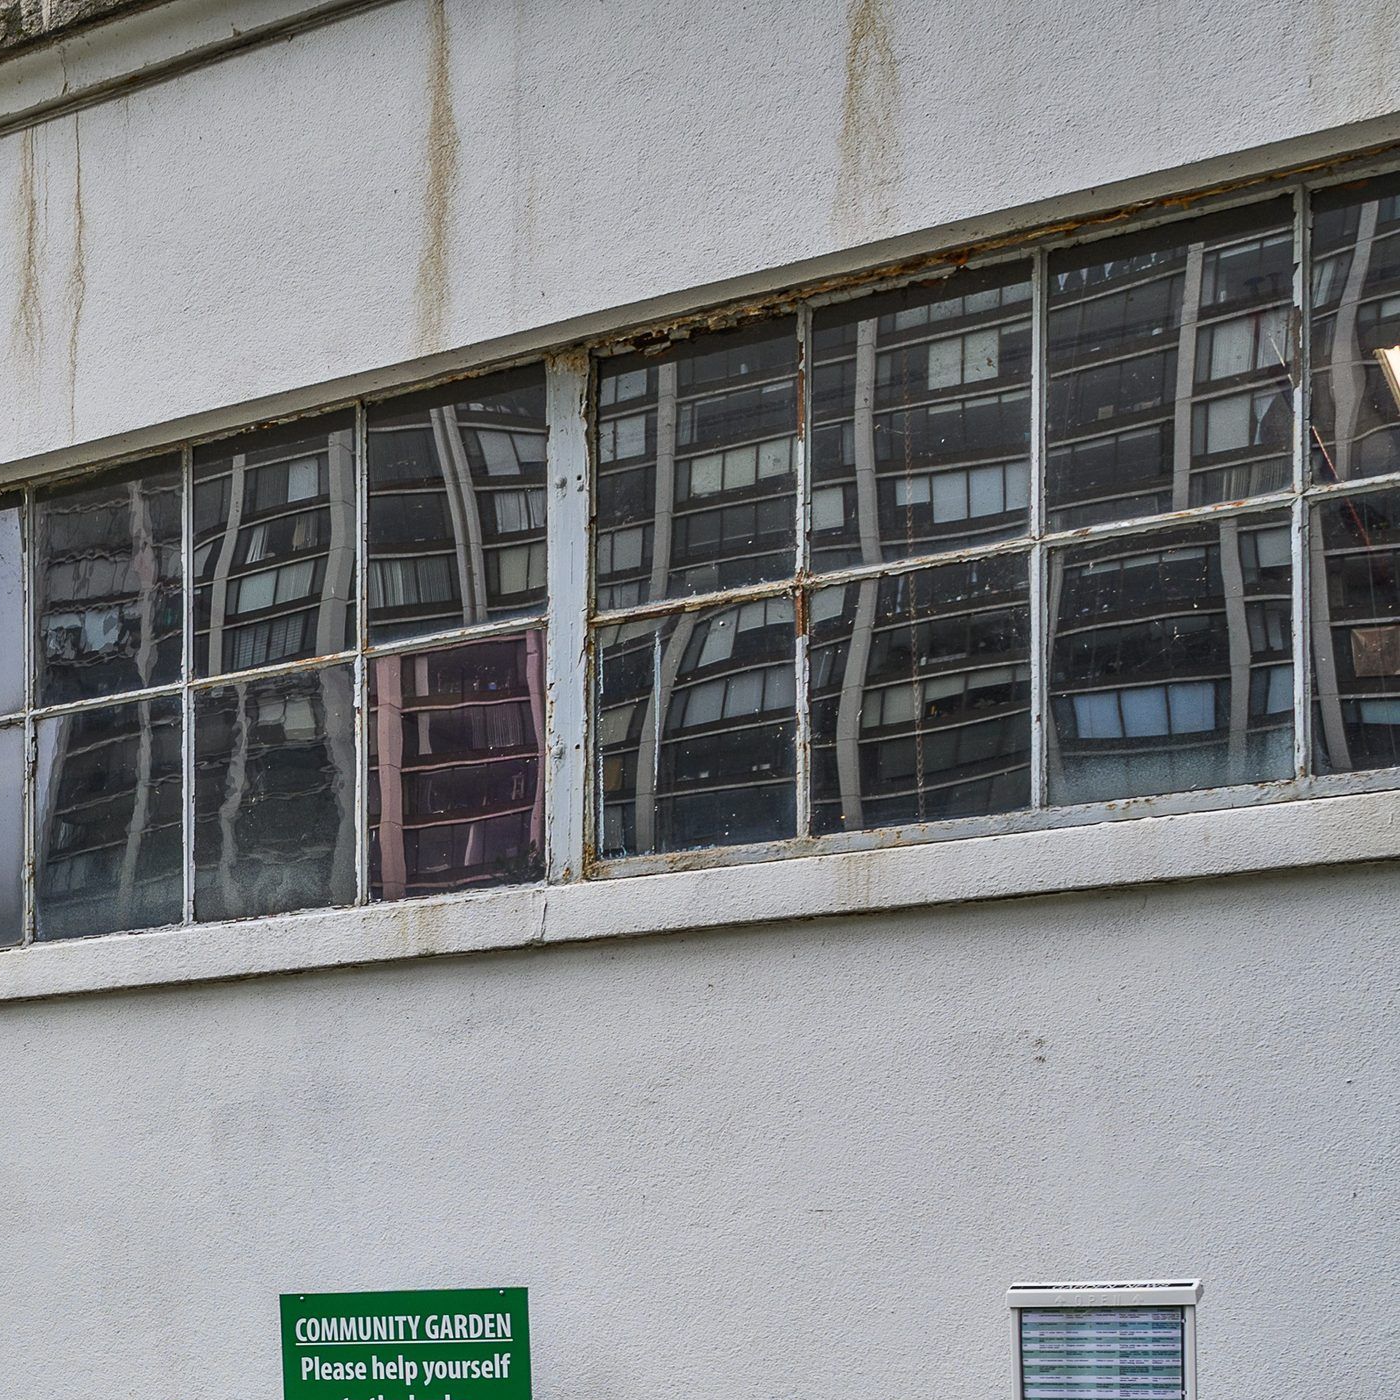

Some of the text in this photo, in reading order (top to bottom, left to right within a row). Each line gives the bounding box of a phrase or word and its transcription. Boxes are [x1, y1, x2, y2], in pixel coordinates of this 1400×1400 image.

[295, 1313, 512, 1342] COMMUNITY GARDEN
[301, 1353, 512, 1386] Please help yourself
